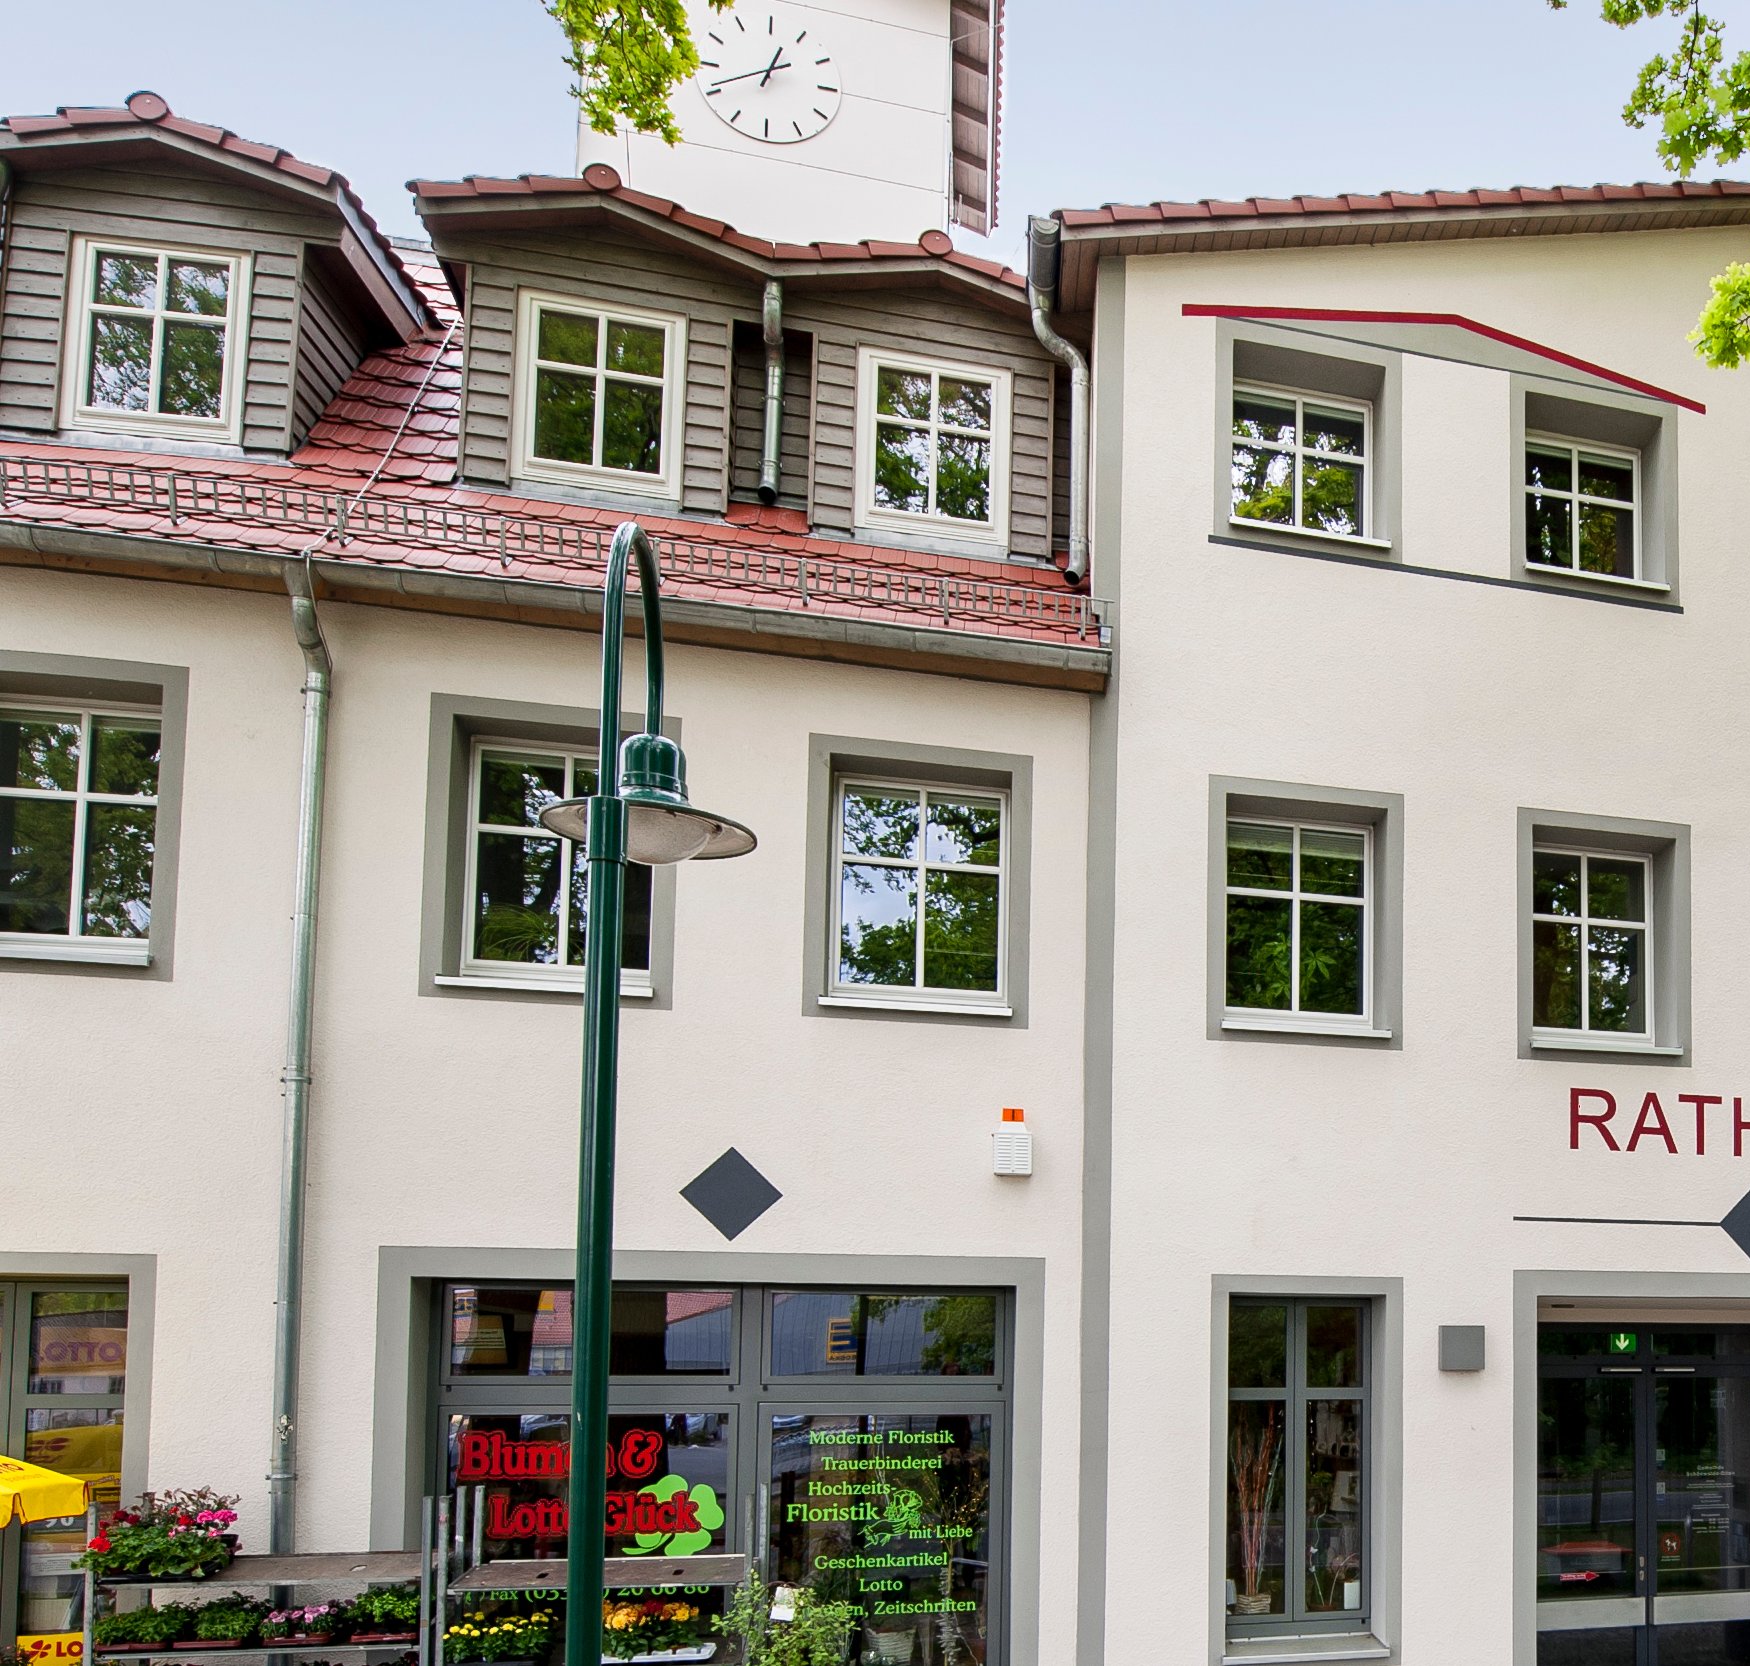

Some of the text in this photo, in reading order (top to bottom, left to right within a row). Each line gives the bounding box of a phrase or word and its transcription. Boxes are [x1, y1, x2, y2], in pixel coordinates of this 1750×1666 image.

[809, 1430, 955, 1445] Moderne Floristik
[458, 1430, 662, 1479] Blum &
[821, 1456, 942, 1471] Trauerbinderei
[808, 1481, 897, 1496] Hochzeits-
[488, 1490, 701, 1538] Lott Glück
[786, 1503, 880, 1523] Floristik
[909, 1525, 973, 1539] mit Liebe
[815, 1553, 948, 1570] Geschenkartikel
[859, 1578, 903, 1593] Lotto
[874, 1598, 977, 1615] Zeitschriften
